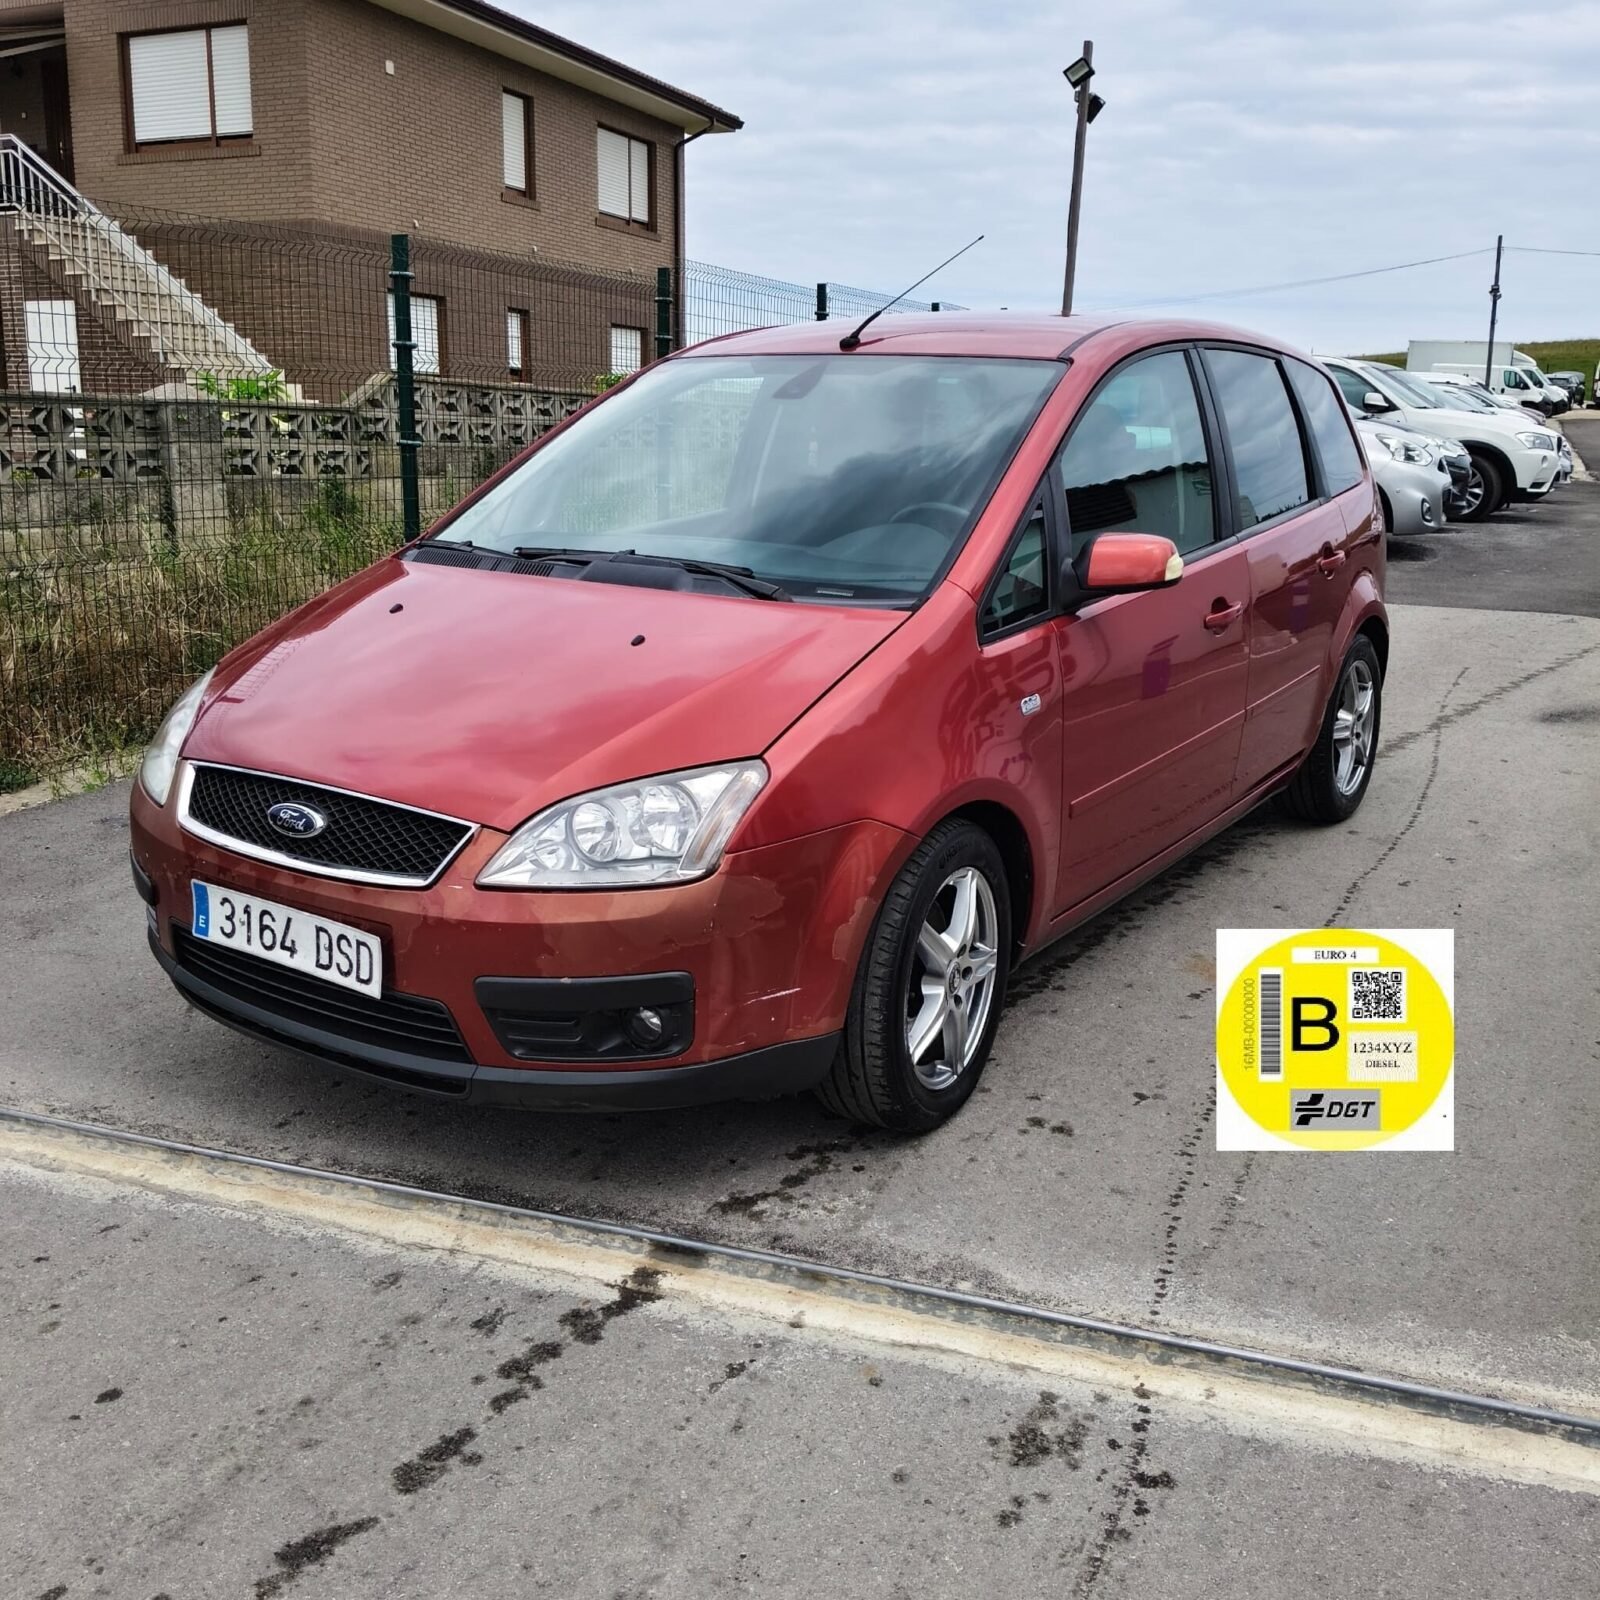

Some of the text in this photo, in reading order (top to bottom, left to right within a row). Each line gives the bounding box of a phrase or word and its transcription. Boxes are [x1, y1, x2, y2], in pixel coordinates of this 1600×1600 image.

[276, 809, 306, 831] Ford
[199, 897, 373, 986] E 3164 DSD
